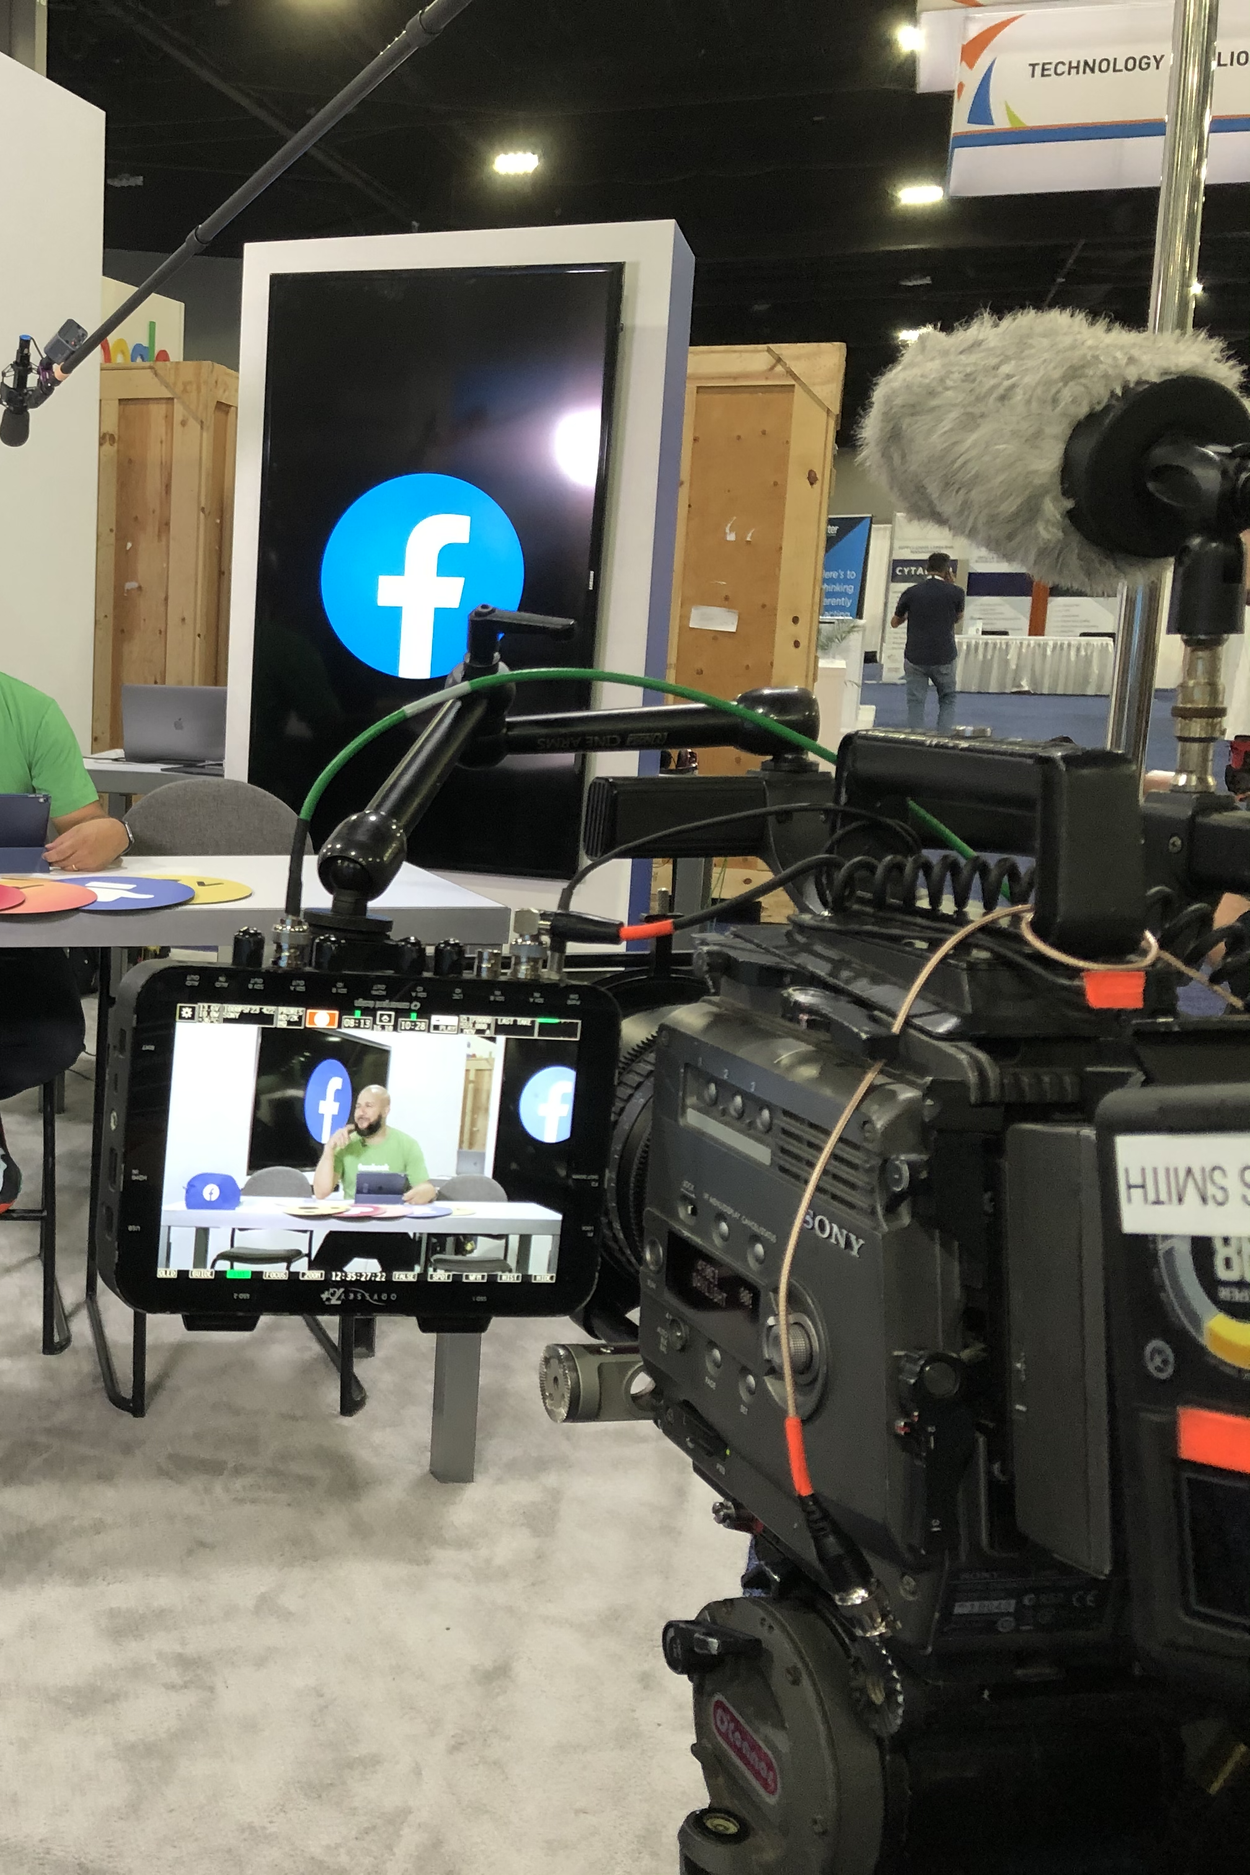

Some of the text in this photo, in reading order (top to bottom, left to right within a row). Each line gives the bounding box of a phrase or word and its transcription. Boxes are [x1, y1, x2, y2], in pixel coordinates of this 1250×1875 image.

[1028, 54, 1166, 78] TECHNOLOGY
[1124, 1165, 1229, 1206] SMITH
[803, 1209, 865, 1258] SONY
[340, 1293, 397, 1301] ODYSSEY
